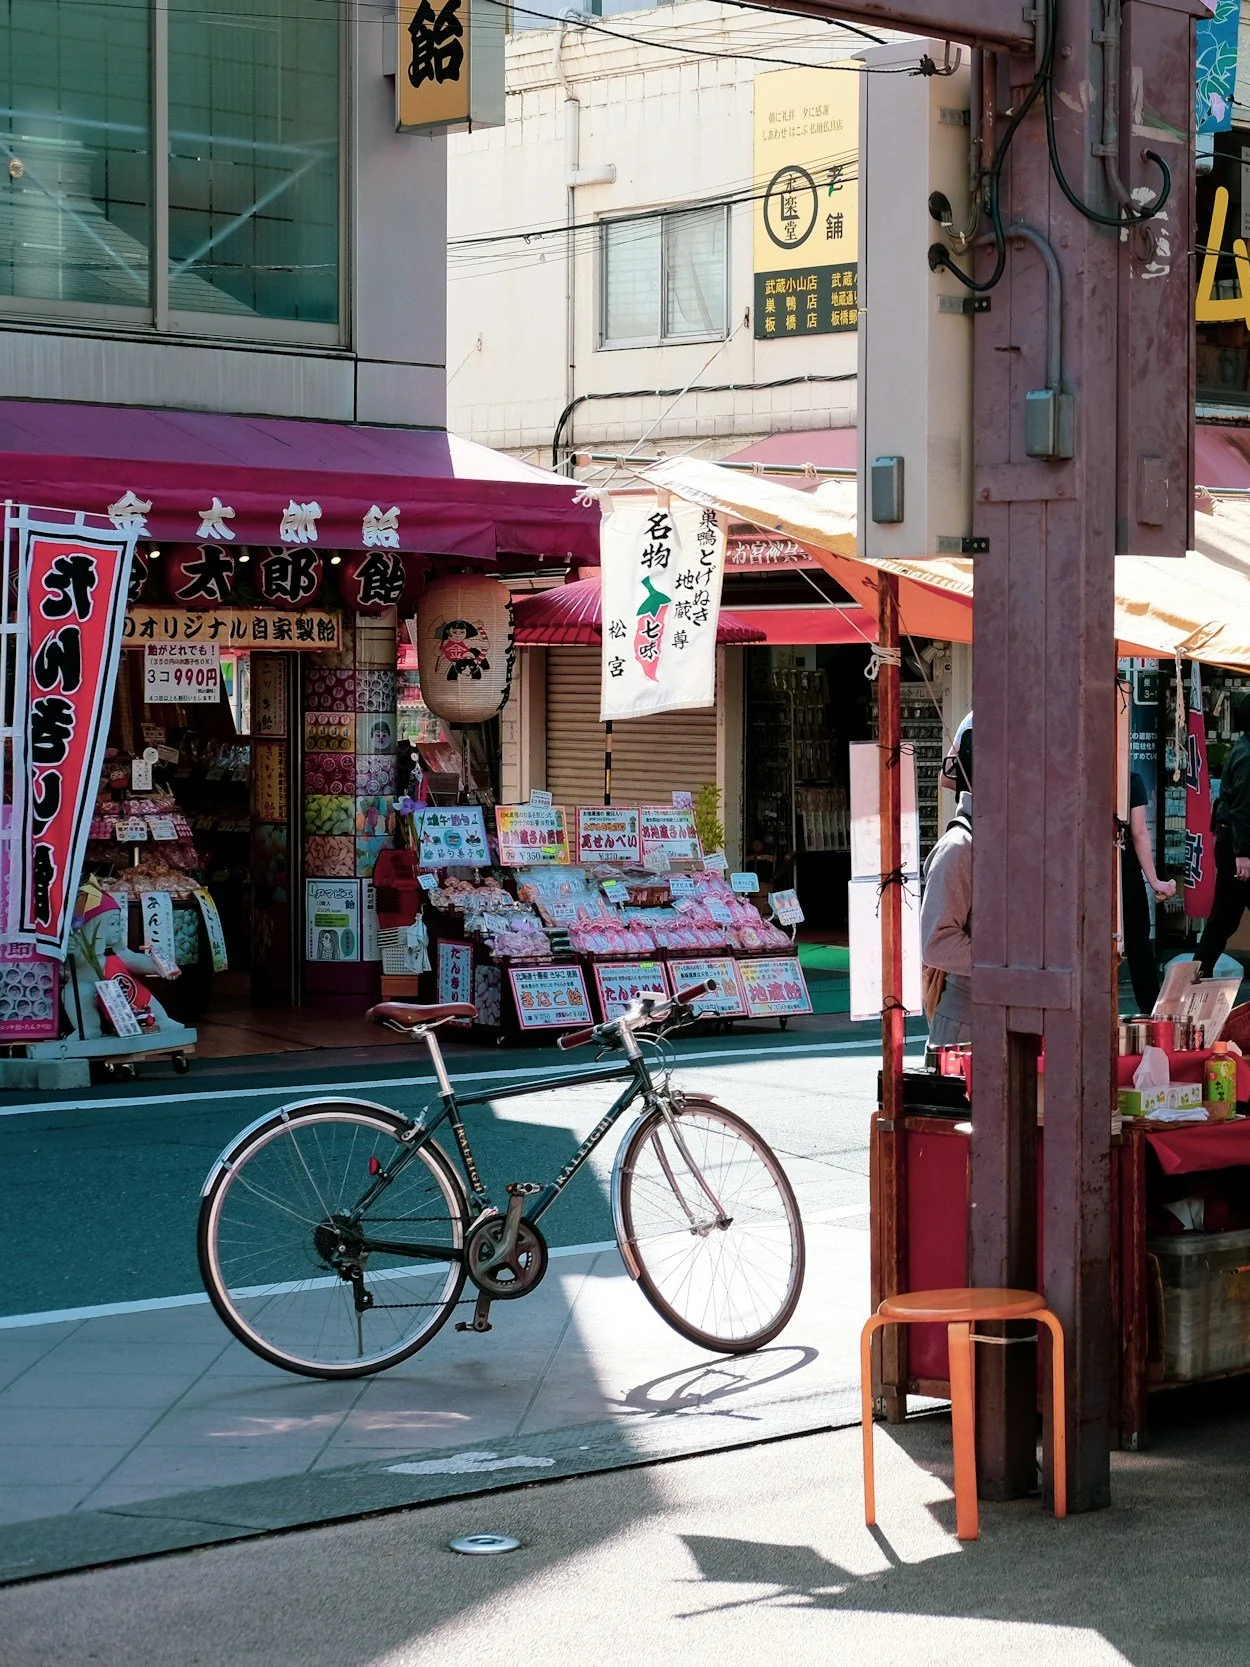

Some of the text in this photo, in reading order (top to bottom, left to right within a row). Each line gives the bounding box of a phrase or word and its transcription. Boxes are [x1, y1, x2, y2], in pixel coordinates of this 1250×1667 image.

[407, 0, 465, 88] 飴
[765, 275, 818, 294] 武蔵小山店
[640, 511, 672, 568] 名物
[639, 618, 661, 662] 七味
[174, 668, 217, 687] 990円
[520, 987, 584, 1008] きなこ飴
[748, 981, 803, 1002] 地蔵飴
[456, 1127, 484, 1193] RALEIGH
[555, 1117, 610, 1186] RALEIGH
